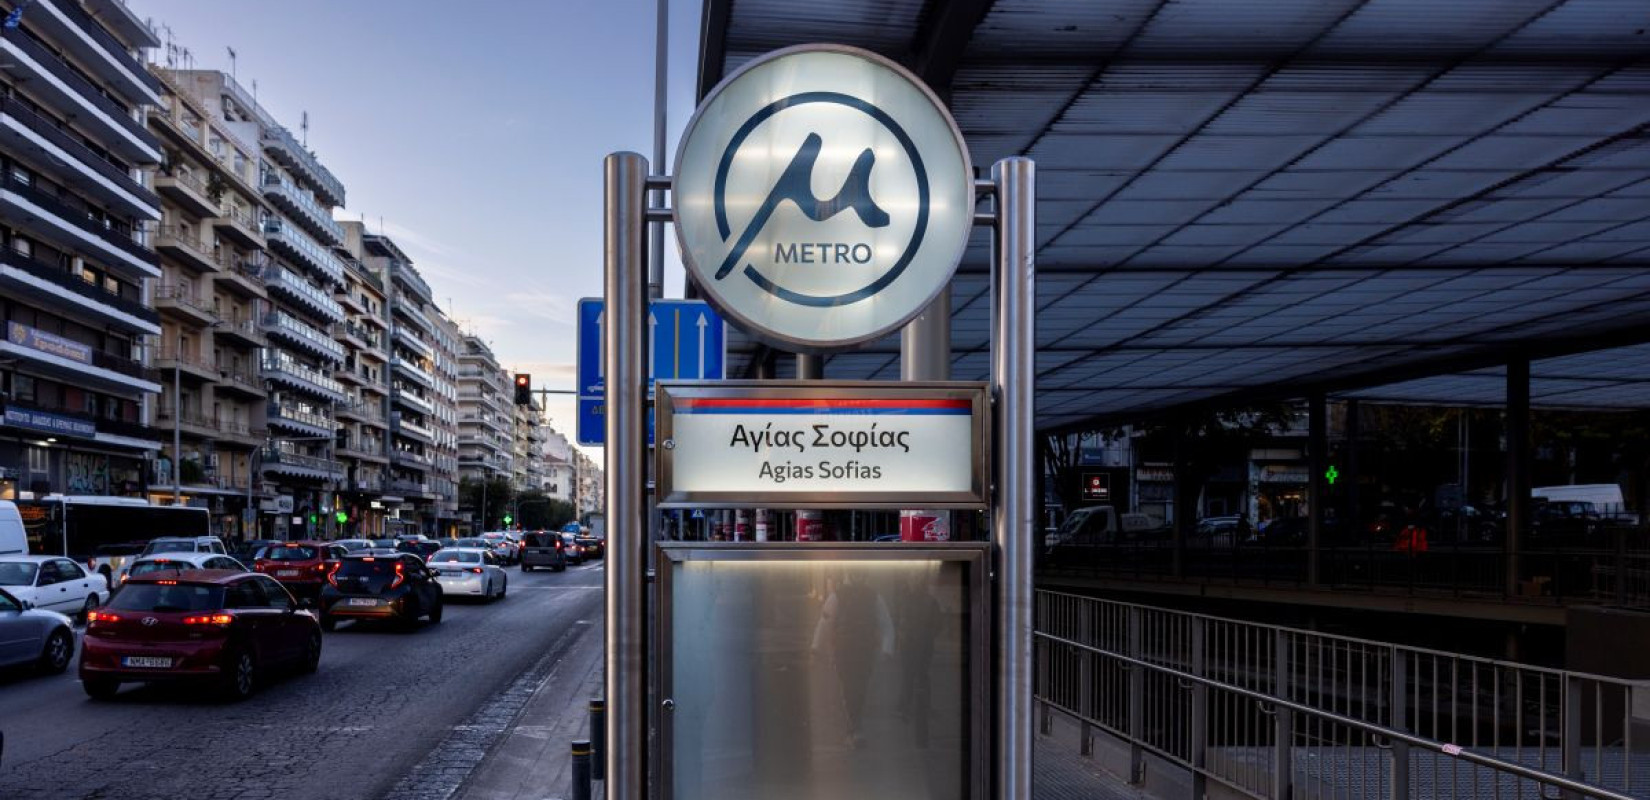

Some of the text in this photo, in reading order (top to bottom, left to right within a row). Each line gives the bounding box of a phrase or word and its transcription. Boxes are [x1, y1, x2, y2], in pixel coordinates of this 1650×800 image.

[774, 242, 873, 265] METRO
[730, 422, 910, 453] Αγίας Σοφίας
[759, 461, 882, 483] Agias Sofias
